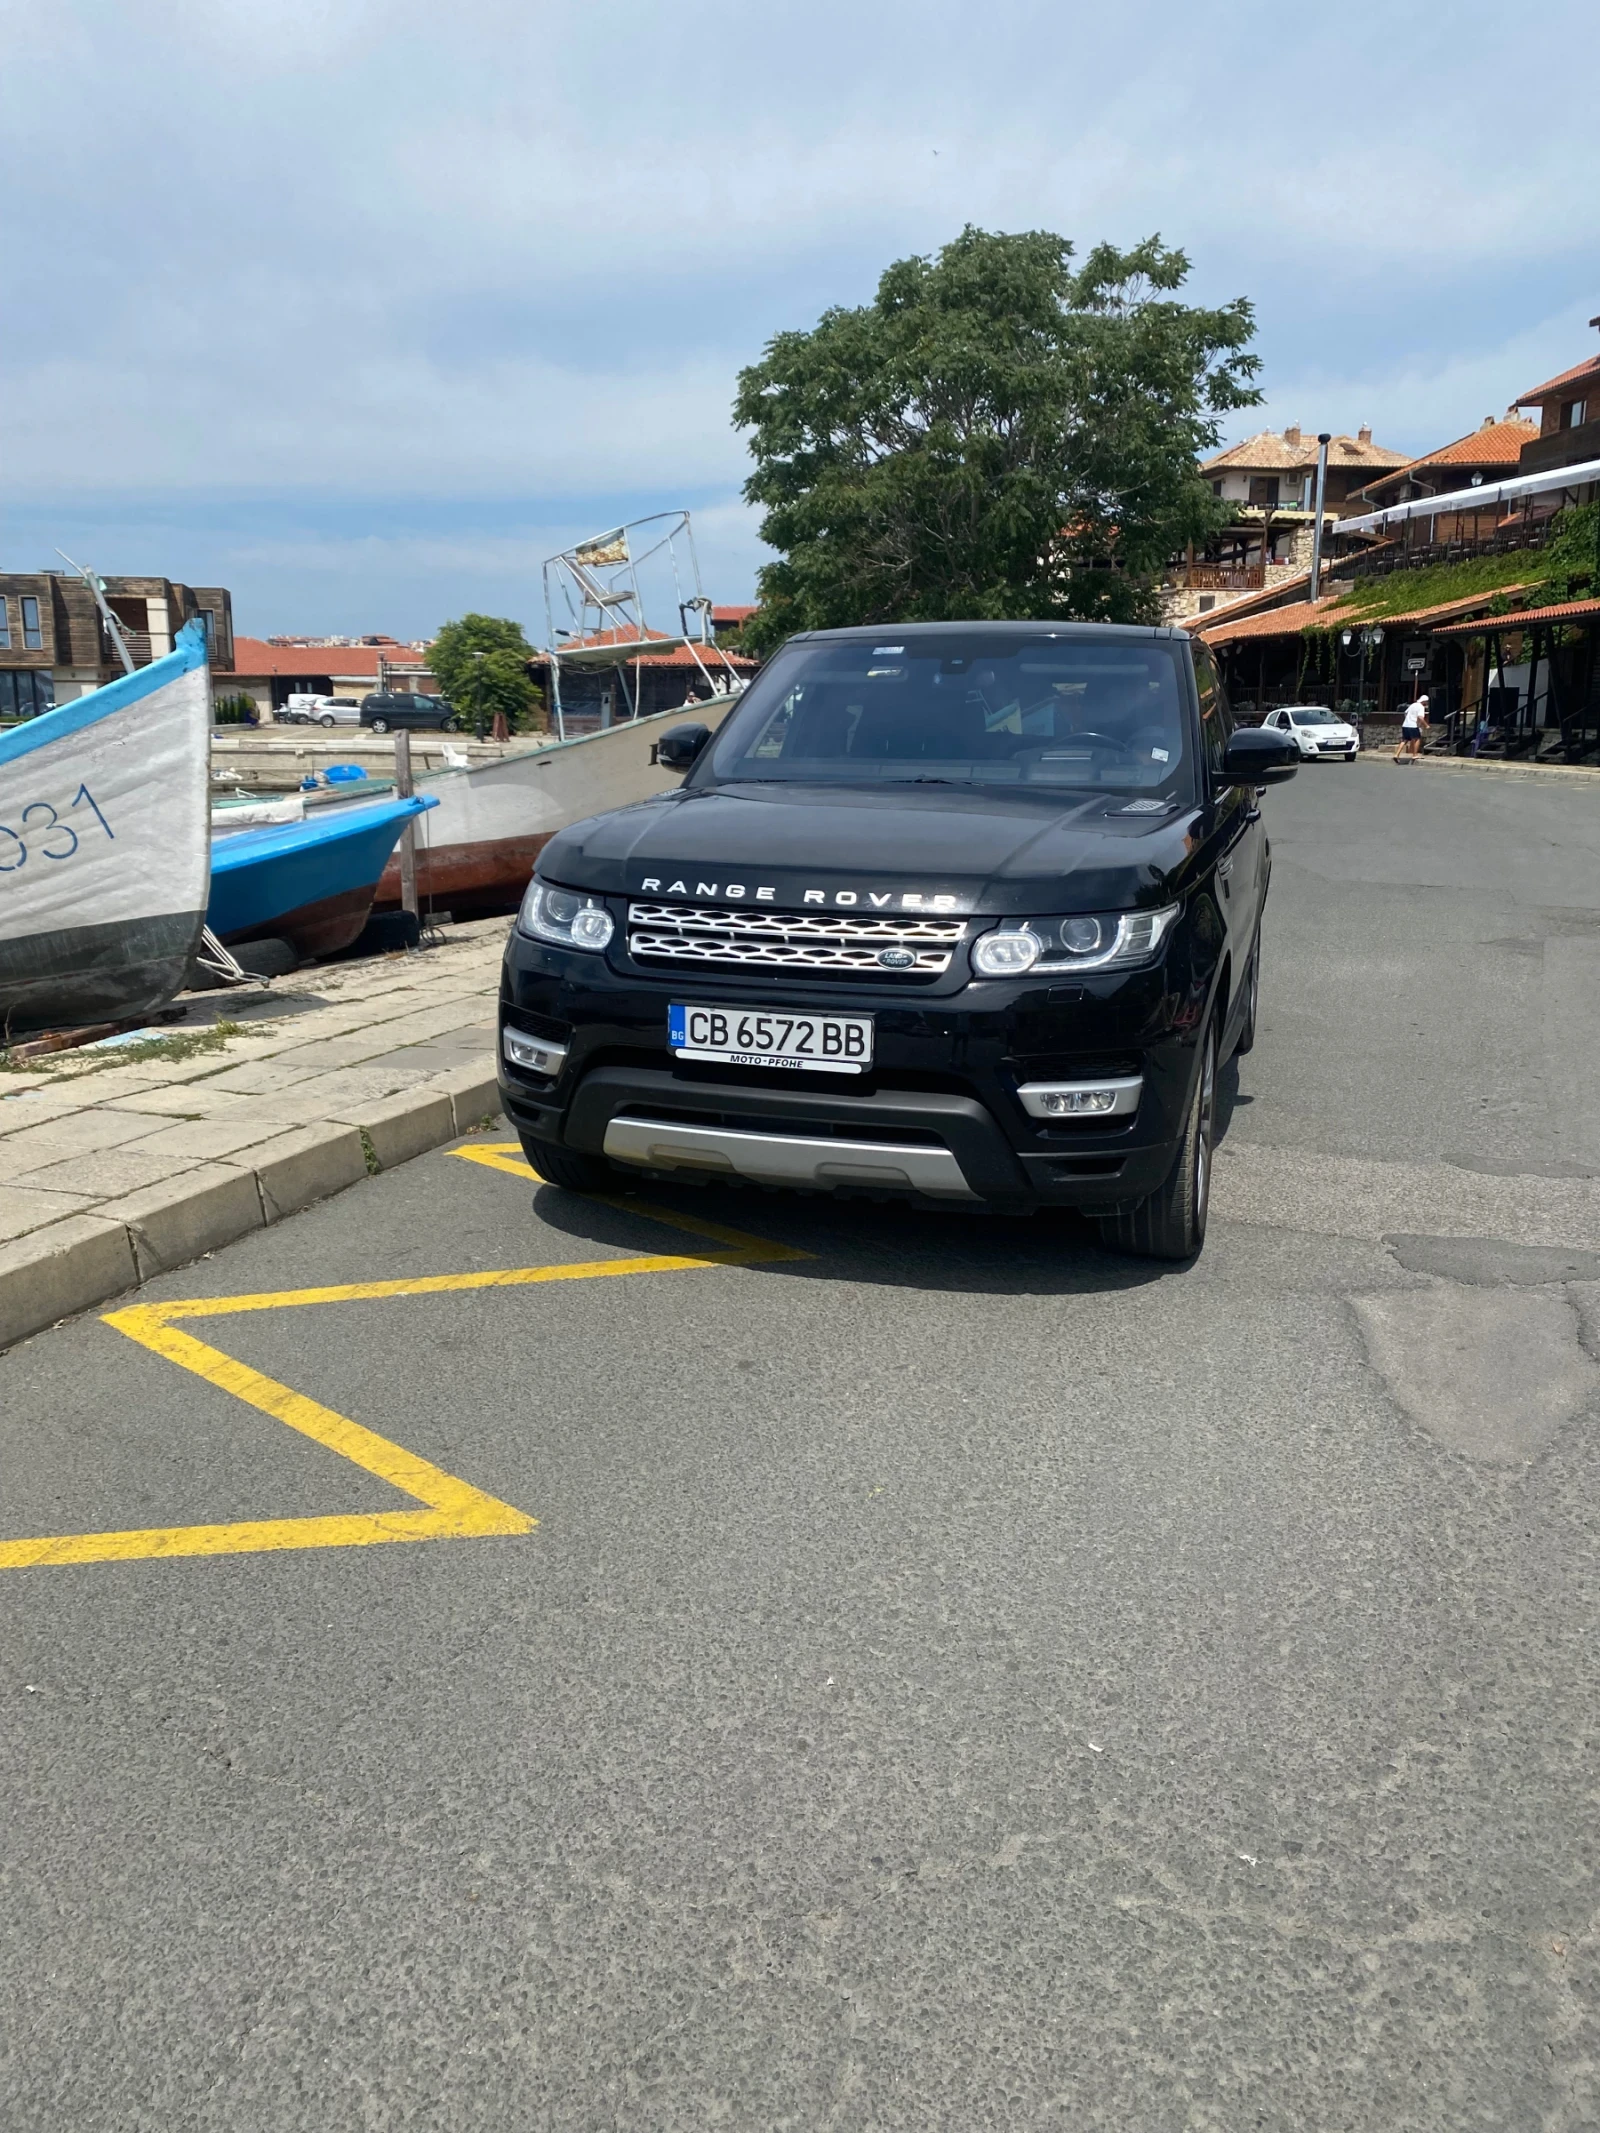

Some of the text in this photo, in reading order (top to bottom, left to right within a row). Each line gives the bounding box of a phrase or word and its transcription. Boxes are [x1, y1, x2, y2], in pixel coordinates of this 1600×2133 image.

[641, 878, 956, 909] RANGE ROVER
[884, 951, 902, 959] LAND
[671, 1030, 684, 1040] BG
[690, 1012, 865, 1057] CB 6572 BB
